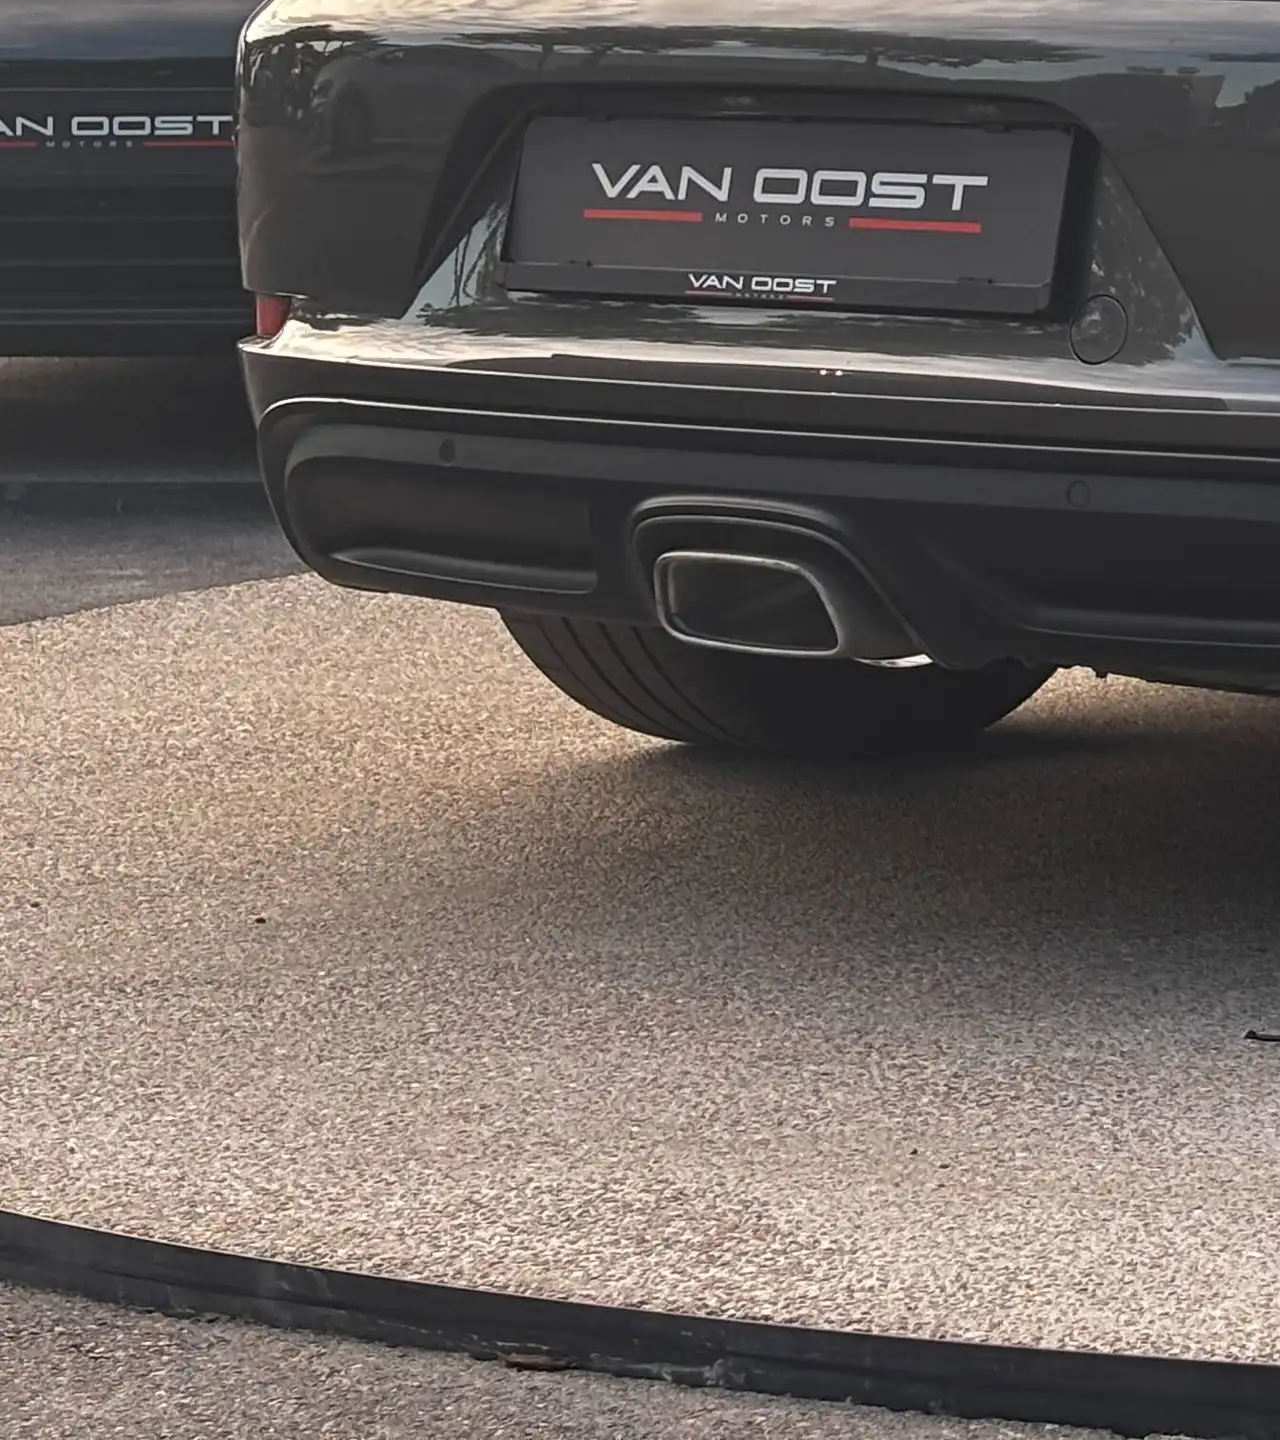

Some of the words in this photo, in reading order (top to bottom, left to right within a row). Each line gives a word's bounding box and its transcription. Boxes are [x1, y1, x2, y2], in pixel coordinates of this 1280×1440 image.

[71, 115, 234, 137] OOST
[591, 162, 733, 203] VAN
[753, 167, 989, 212] OOST
[714, 211, 836, 228] MOTORS
[688, 273, 744, 290] VAN
[751, 276, 838, 294] OOST
